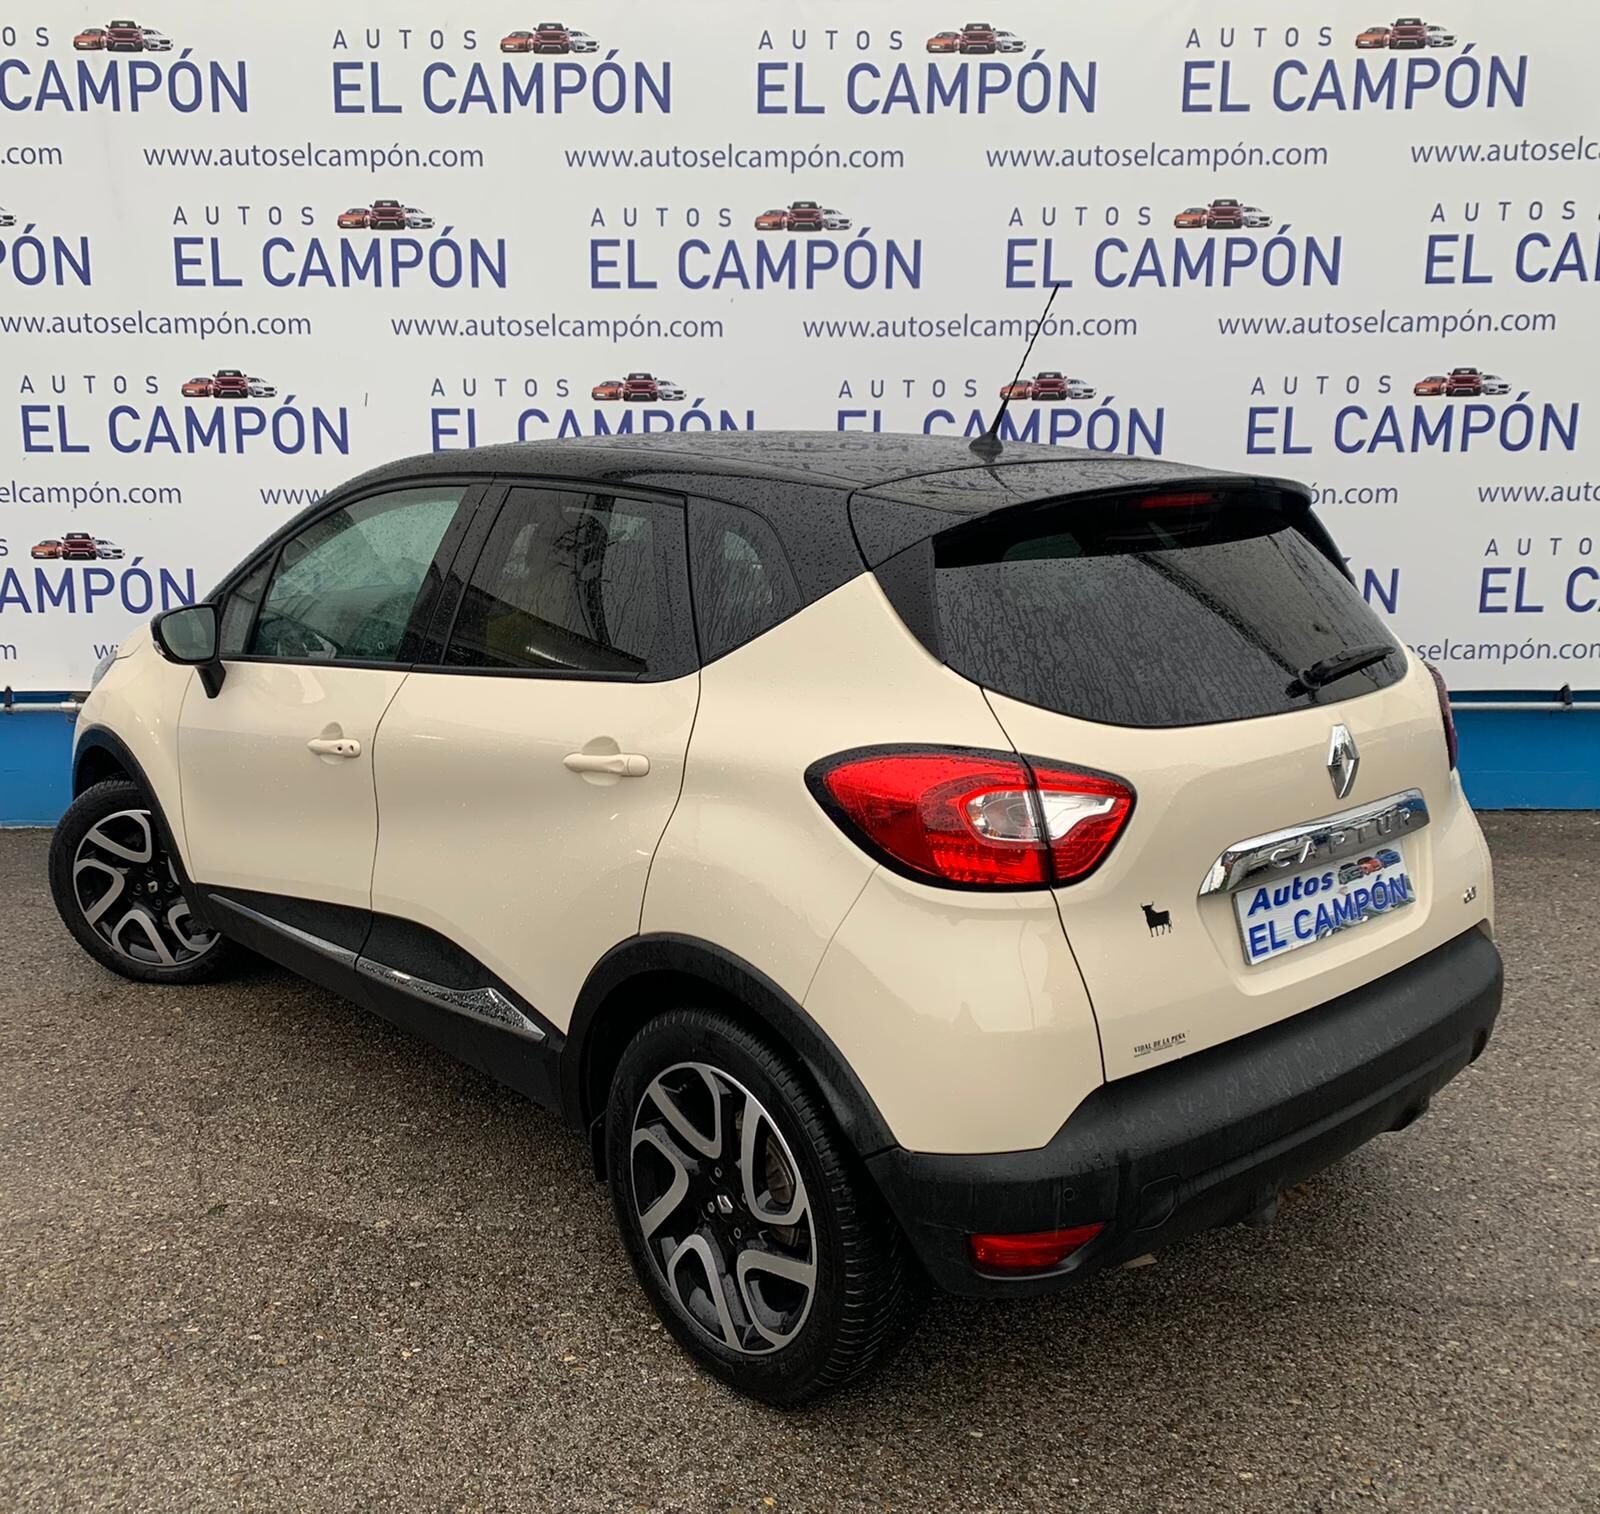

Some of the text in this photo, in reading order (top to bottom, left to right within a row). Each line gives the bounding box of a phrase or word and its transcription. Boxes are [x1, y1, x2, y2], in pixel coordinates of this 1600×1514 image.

[333, 29, 476, 49] AUTOS
[759, 30, 902, 50] AUTOS
[1186, 27, 1331, 48] AUTOS
[0, 49, 247, 112] CAMPÓN
[333, 49, 671, 114] EL CAMPÓN
[758, 49, 1096, 114] EL CAMPÓN
[1182, 43, 1527, 112] EL CAMPÓN
[144, 143, 483, 172] www.autoselcampón.com
[565, 144, 903, 173] www.autoselcampón.com
[987, 142, 1327, 172] www.autoselcampón.com
[1412, 136, 1600, 163] www.autoselc
[173, 206, 313, 225] AUTOS
[591, 208, 731, 227] AUTOS
[1009, 207, 1150, 226] AUTOS
[1431, 201, 1575, 222] AUTOS
[174, 226, 506, 288] EL CAMPÓN
[591, 227, 921, 290] EL CAMPÓN
[1006, 224, 1341, 288] EL CAMPÓN
[1425, 232, 1600, 284] EL CA
[391, 313, 722, 343] www.autoselcampón.com
[803, 314, 1137, 343] www.autoselcampón.com
[1219, 309, 1555, 338] www.autoselcampón.com
[21, 376, 158, 394] AUTOS
[431, 378, 569, 397] AUTOS
[839, 379, 977, 398] AUTOS
[1251, 375, 1391, 395] AUTOS
[21, 395, 349, 454] EL CAMPÓN
[1247, 391, 1579, 454] EL CAMPÓN
[1479, 567, 1543, 613] EL
[1270, 807, 1411, 868] CAPTUR
[1247, 872, 1334, 917] Autos
[1249, 873, 1408, 958] EL CAMPÓN
